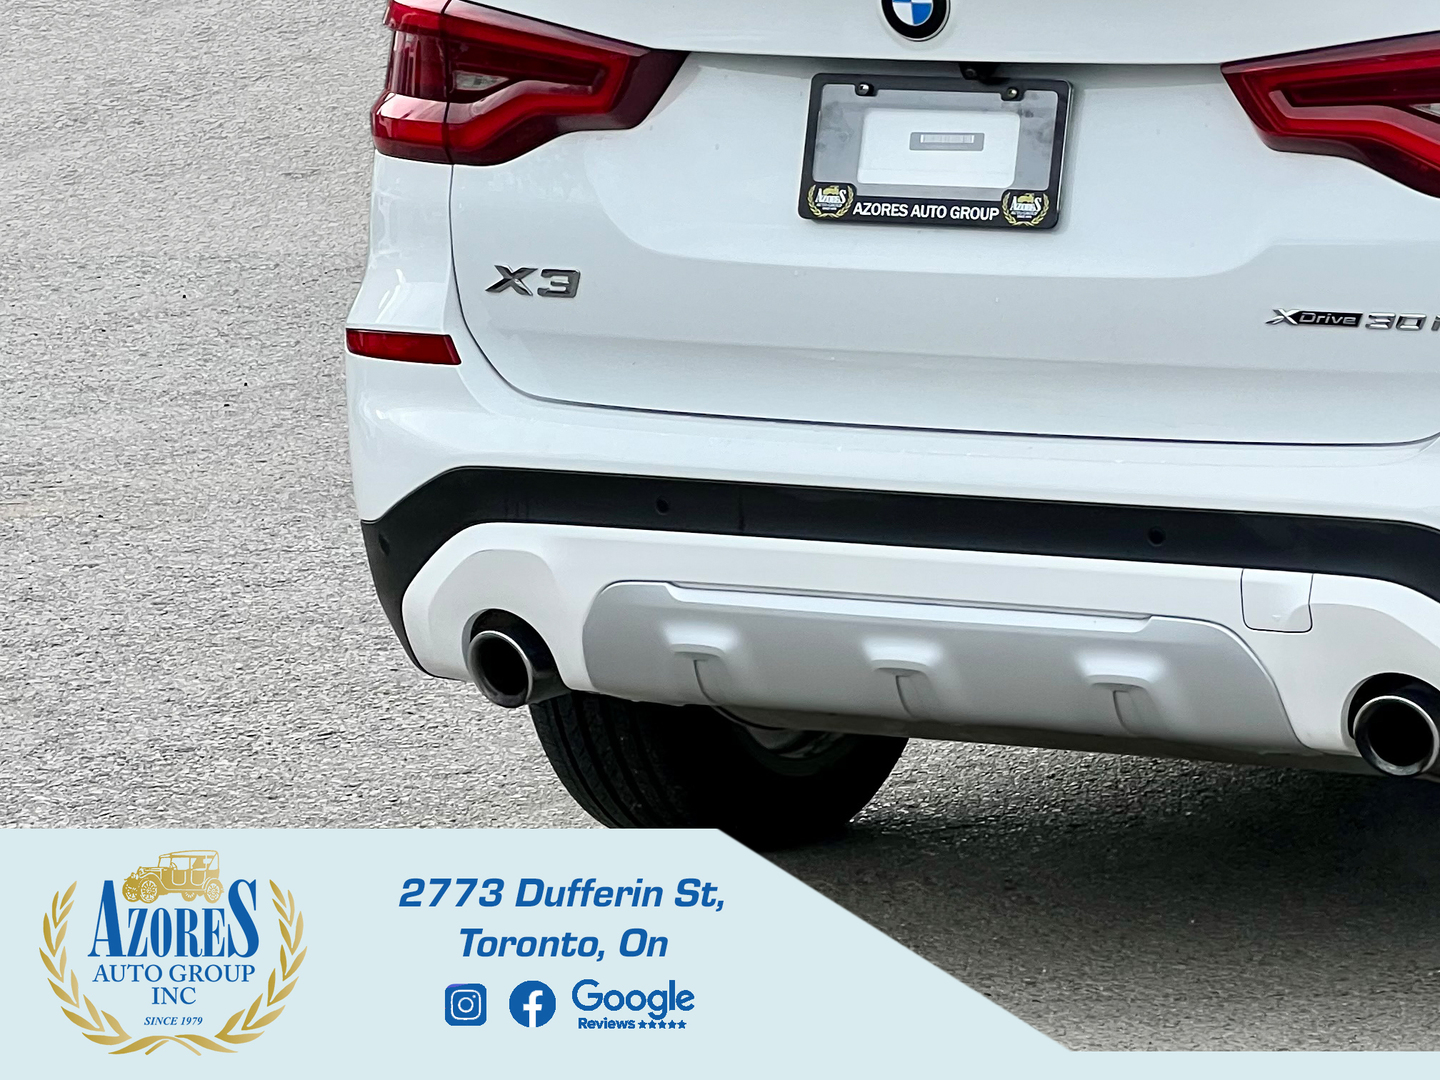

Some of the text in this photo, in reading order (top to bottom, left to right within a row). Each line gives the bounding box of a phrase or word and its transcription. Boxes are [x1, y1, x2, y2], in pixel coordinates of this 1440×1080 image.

[852, 202, 1000, 221] AZORES AUTO GROUP
[485, 264, 581, 298] X3
